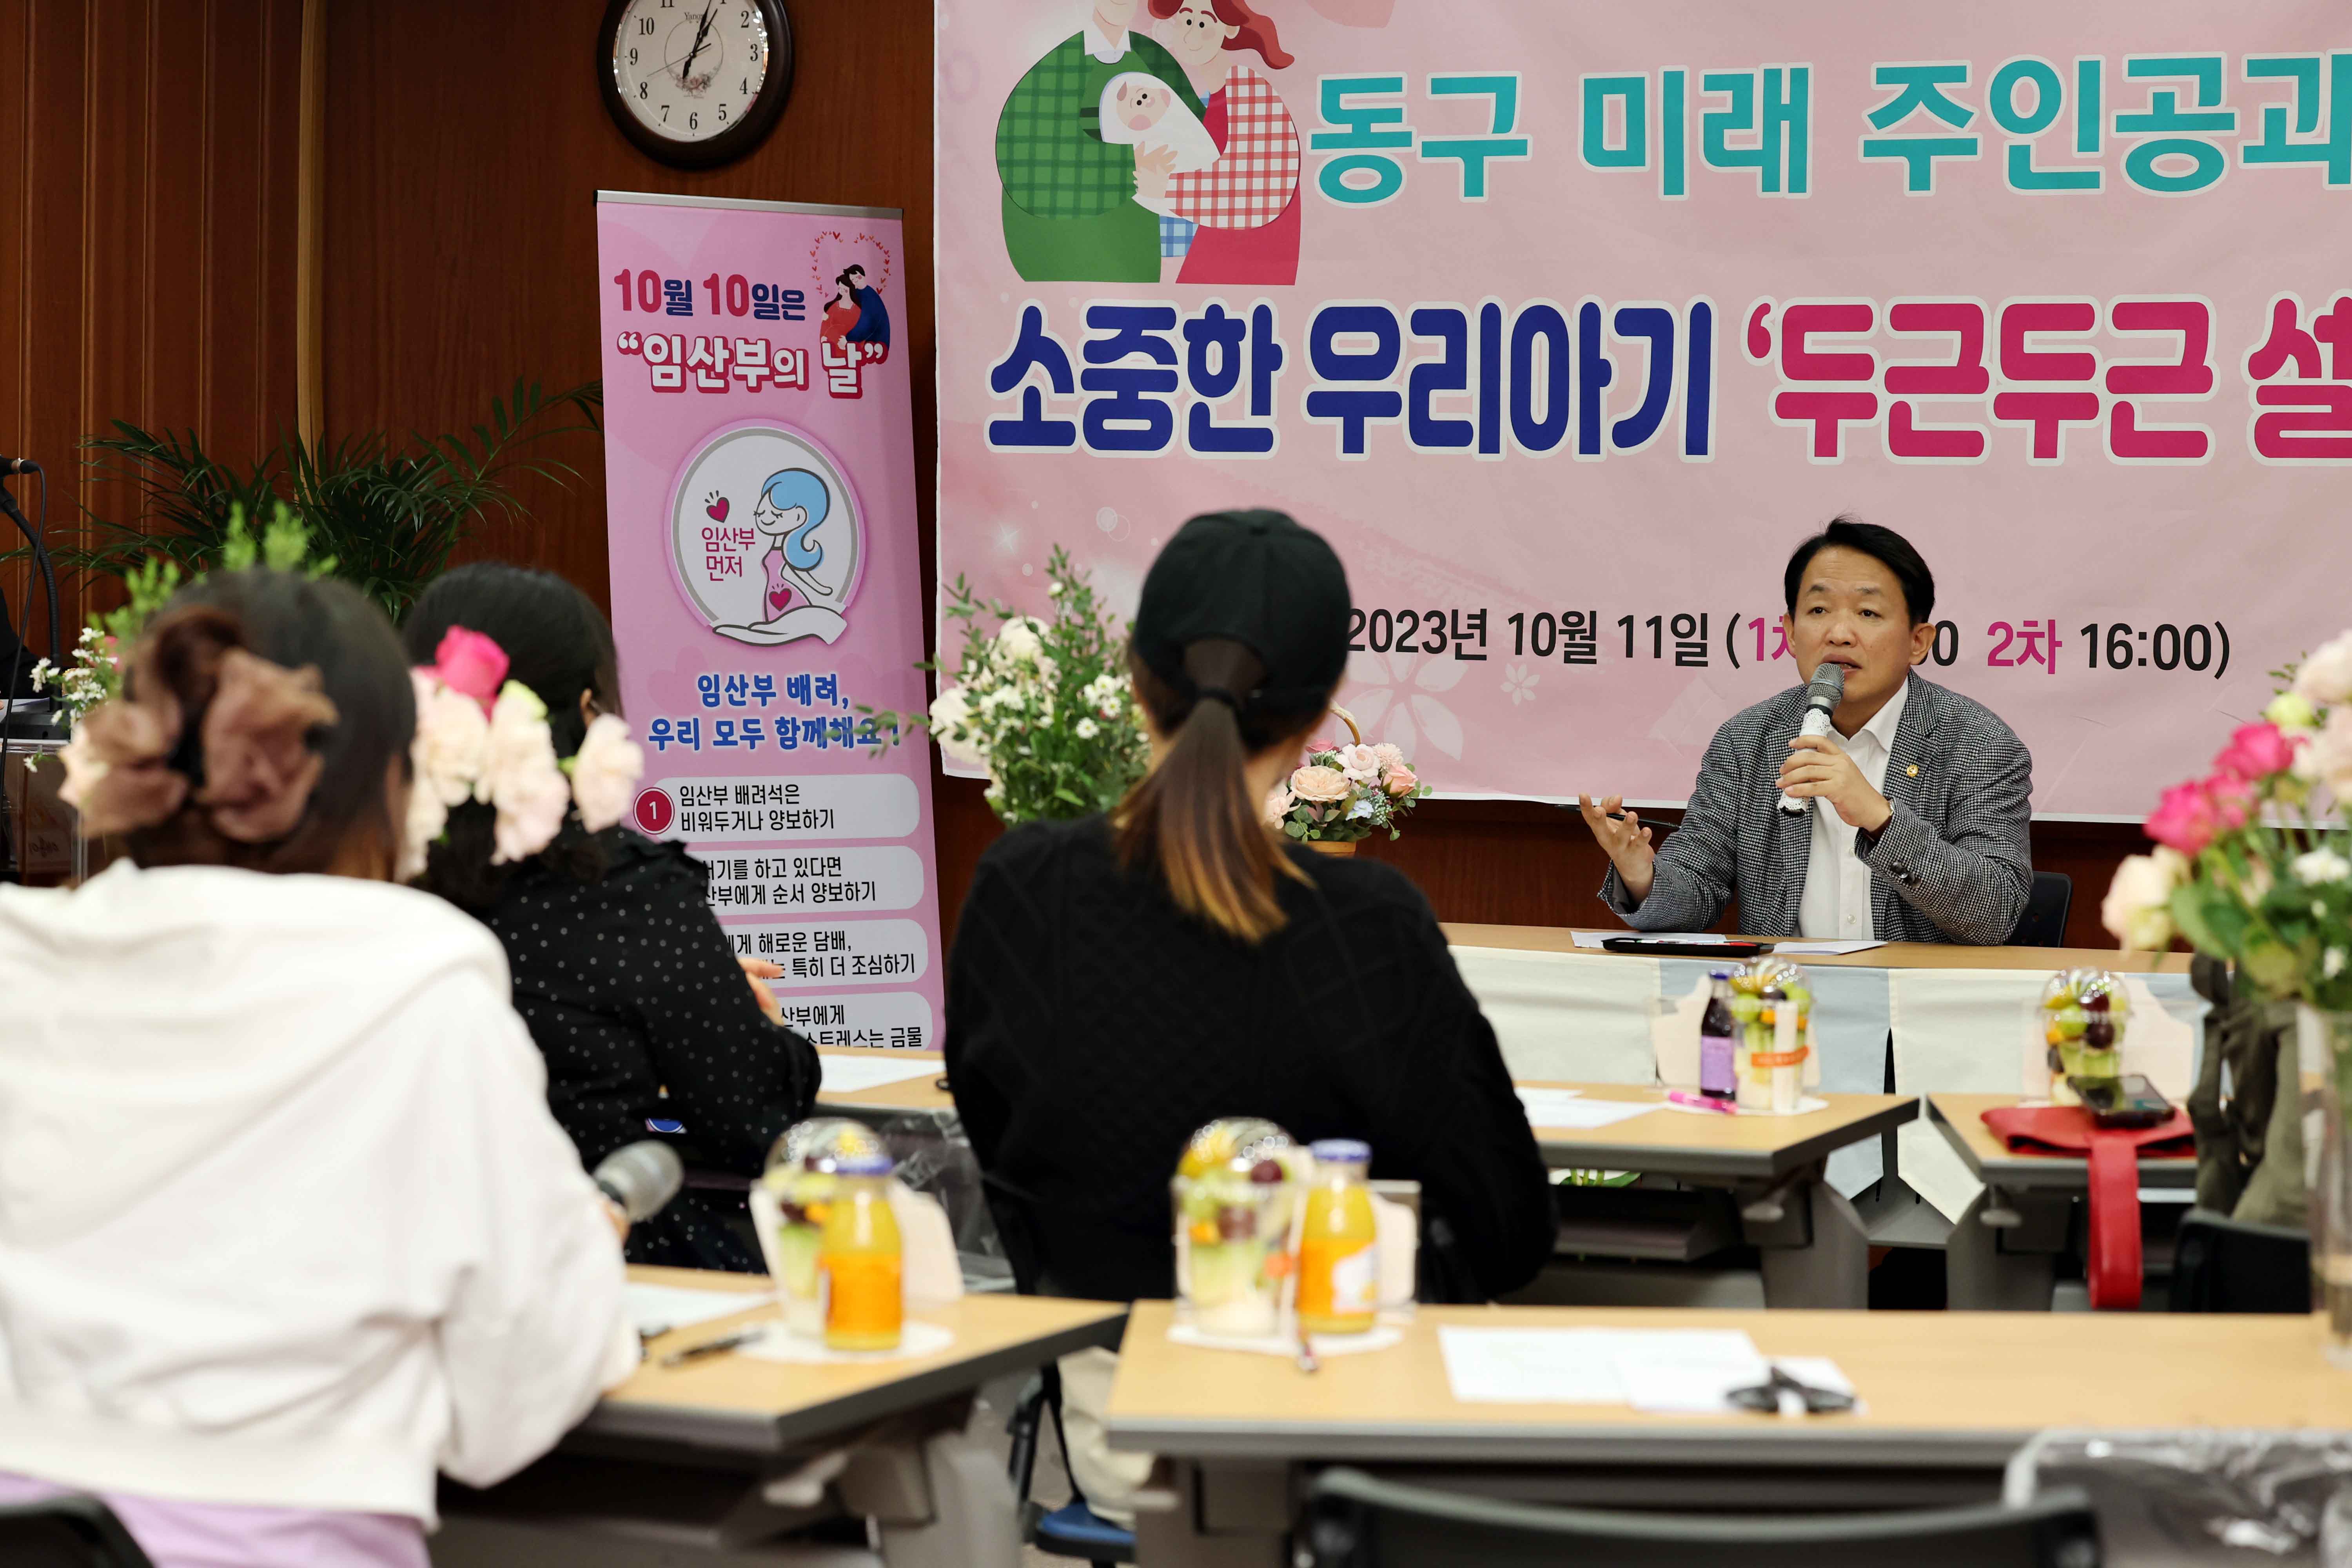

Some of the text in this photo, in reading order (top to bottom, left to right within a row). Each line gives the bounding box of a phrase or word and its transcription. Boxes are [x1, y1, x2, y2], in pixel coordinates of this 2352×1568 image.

[639, 17, 655, 35] 10
[741, 11, 749, 28] 2
[630, 48, 638, 65] 9
[750, 44, 758, 61] 3
[640, 82, 648, 100] 8
[740, 77, 748, 94] 4
[661, 105, 670, 122] 7
[689, 112, 698, 129] 6
[718, 103, 727, 121] 5
[1311, 54, 2352, 203] 동구 미래 주인공과
[614, 269, 806, 321] 10월 10일은
[989, 304, 1283, 453] 소중한
[1306, 302, 1712, 456] 우리아기
[702, 527, 756, 552] 임산부
[706, 555, 742, 581] 먼저
[1347, 608, 1487, 661] 2023년
[1508, 610, 1597, 665] 10월
[1617, 612, 1709, 668] 11일
[1987, 619, 2063, 675] 2차
[2080, 621, 2230, 680] 16:00)
[698, 673, 849, 710] 임산부 배려,
[648, 717, 700, 751] 우리
[713, 719, 765, 750] 모두
[680, 784, 800, 807] 임산부 배려석은
[649, 801, 657, 820] 1
[681, 808, 834, 832] 비워두거나 양보하기
[754, 858, 787, 879] 하고
[793, 856, 842, 878] 있다면
[773, 883, 804, 905] 순서
[811, 881, 876, 904] 양보하기
[758, 932, 808, 954] 해로운
[813, 930, 852, 953] 담배,
[792, 956, 824, 978] 특히
[830, 955, 846, 977] 더
[852, 953, 915, 976] 조심하기
[890, 1026, 922, 1048] 금물
